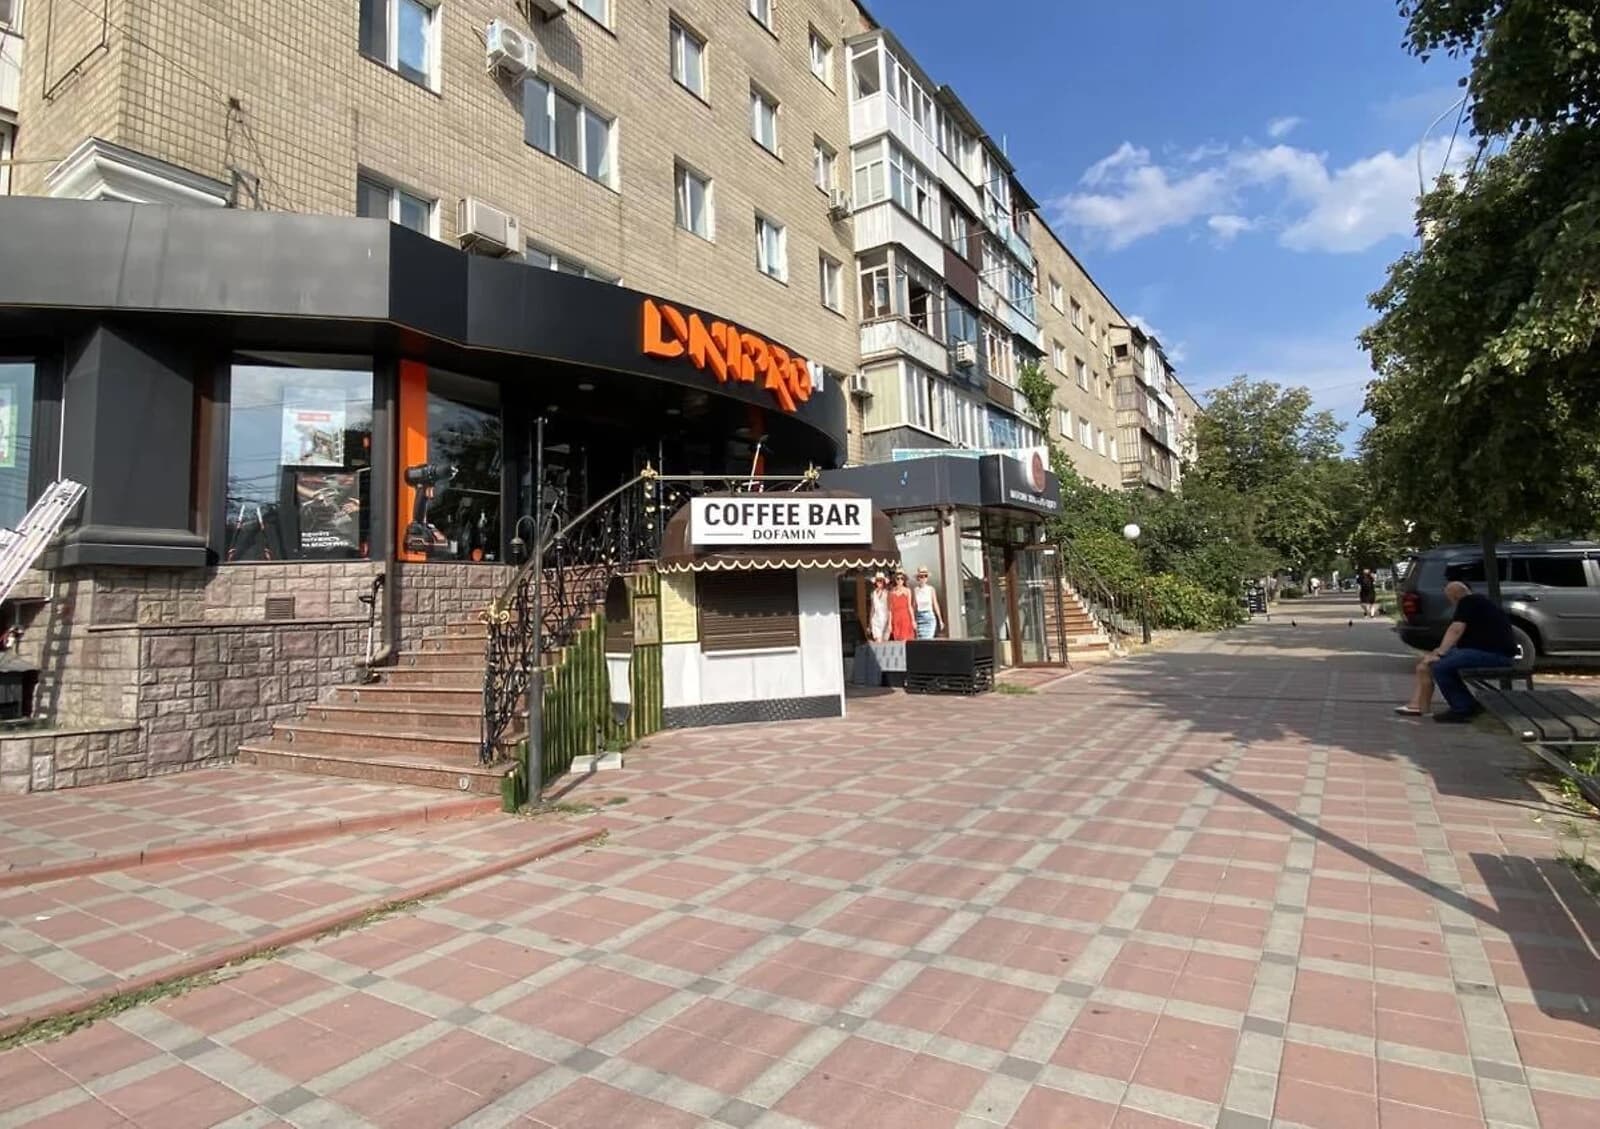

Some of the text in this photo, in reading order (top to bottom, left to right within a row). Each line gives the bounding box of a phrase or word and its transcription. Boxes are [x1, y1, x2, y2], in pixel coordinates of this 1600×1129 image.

[642, 298, 813, 413] DNIPRO
[704, 503, 861, 526] COFFEE BAR
[753, 529, 816, 540] DOFAMIN
